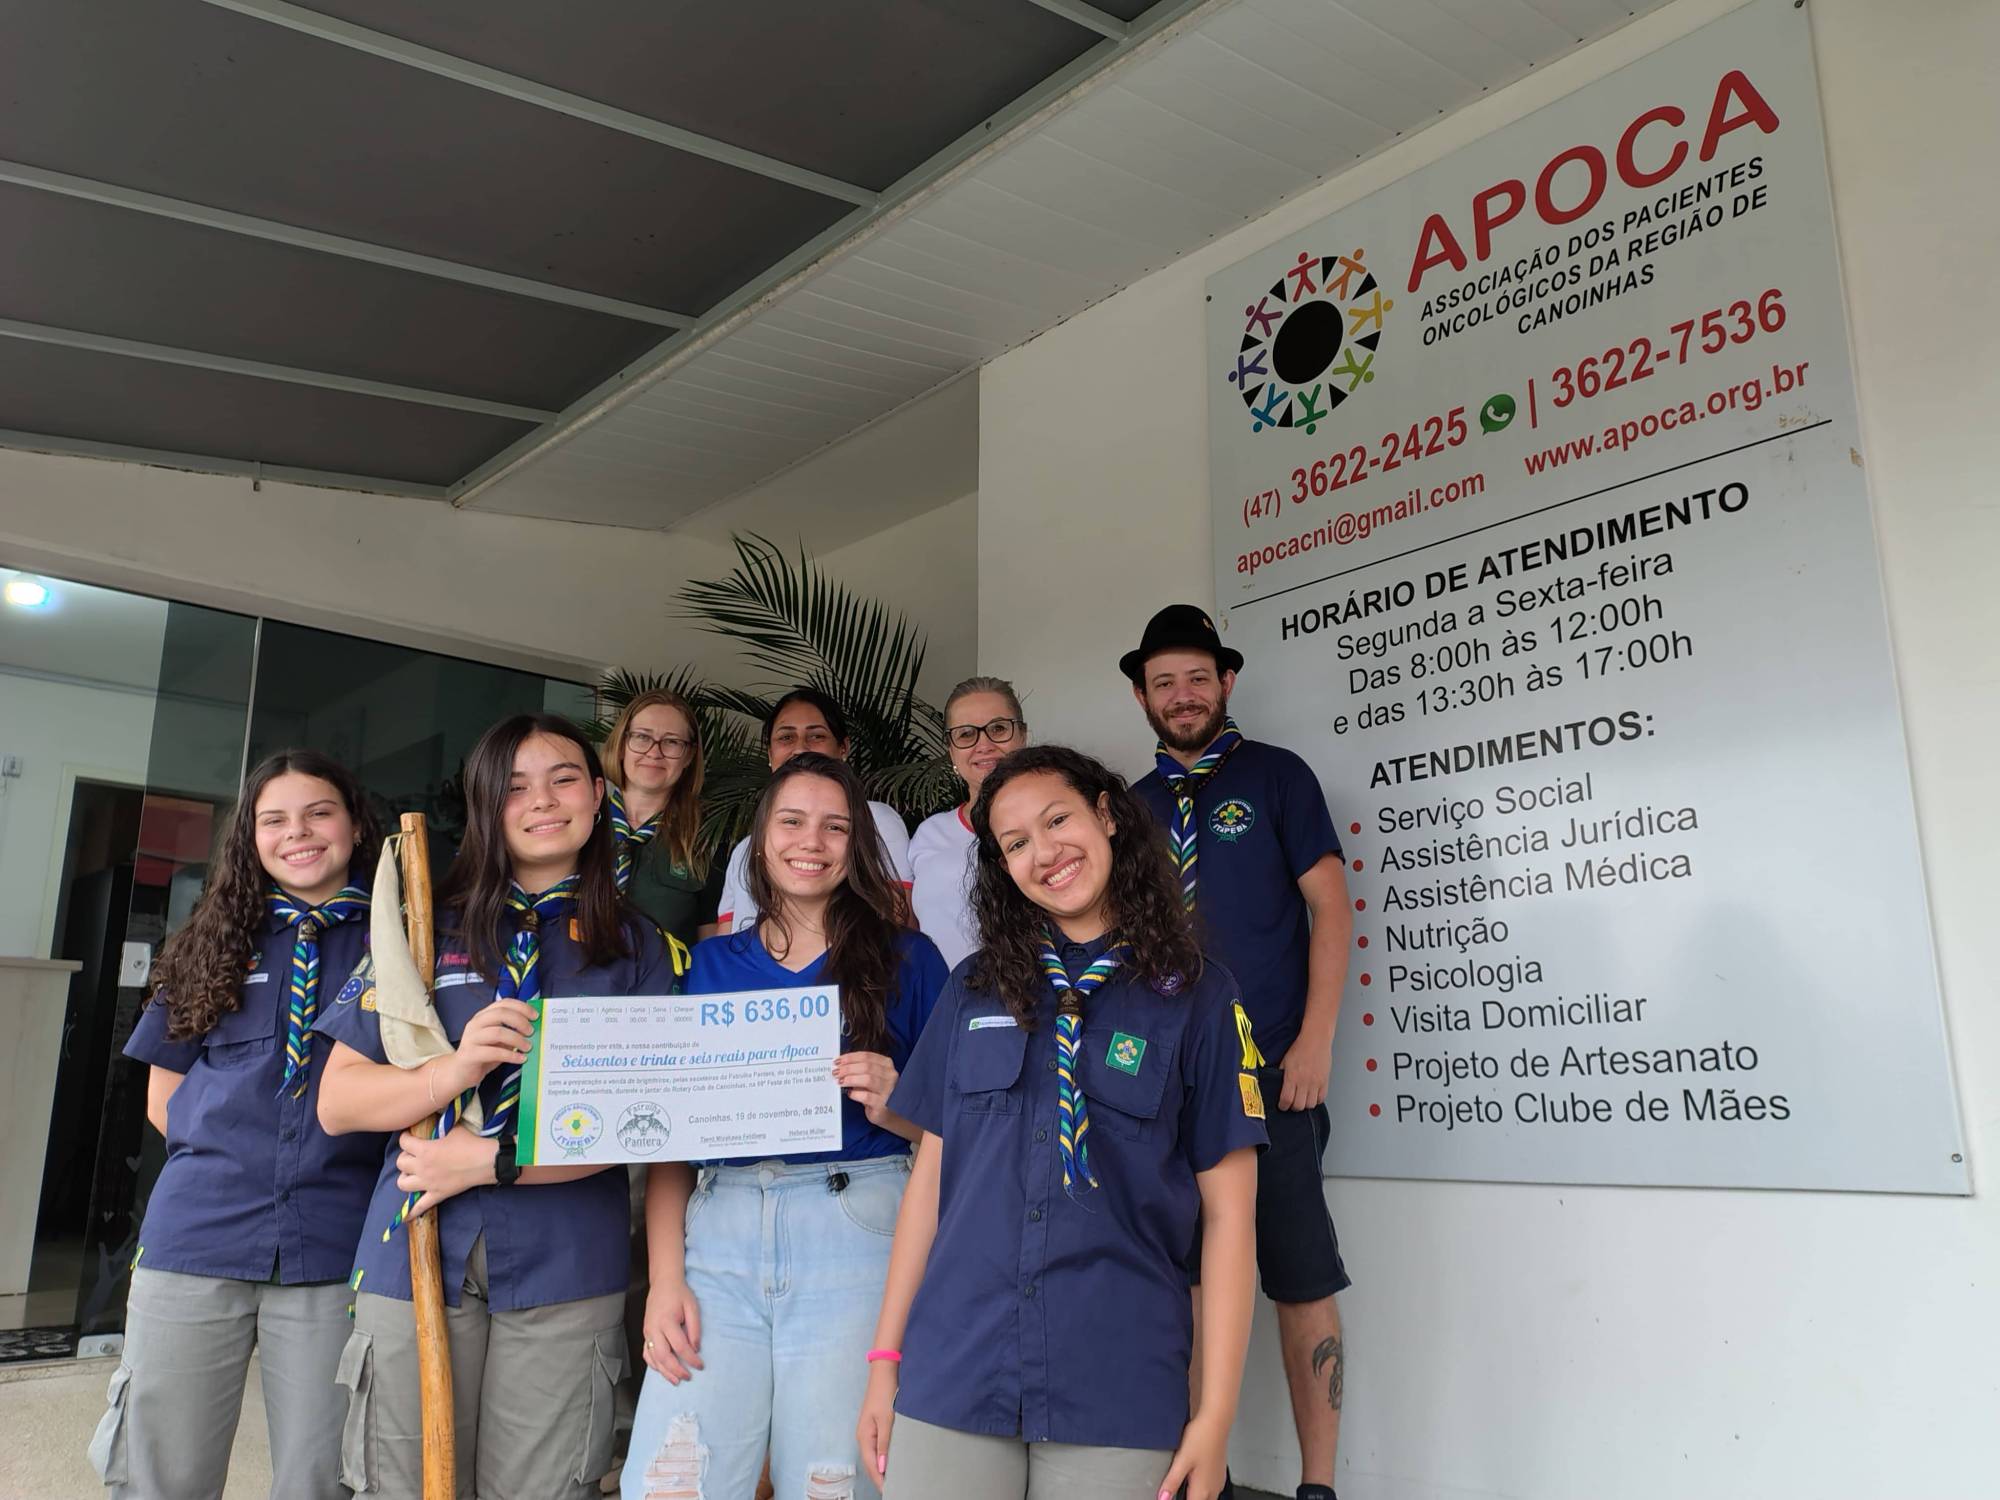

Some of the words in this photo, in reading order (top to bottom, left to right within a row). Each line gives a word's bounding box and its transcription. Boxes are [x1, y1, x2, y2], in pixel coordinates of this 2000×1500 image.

[1407, 70, 1780, 294] APOCA
[1420, 244, 1561, 322] ASSOCIAÇÃO
[1567, 220, 1615, 258] DOS
[1623, 156, 1763, 234] PACIENTES
[1422, 264, 1581, 346] ONCOLÓGICOS
[1589, 248, 1621, 278] DA
[1627, 205, 1724, 262] REGIÃO
[1732, 184, 1768, 219] DE
[1517, 263, 1654, 335] CANOINHAS
[1243, 488, 1281, 529] (47)
[1291, 406, 1468, 504] 3622-2425
[1551, 288, 1787, 408] 3622-7536
[1524, 362, 1809, 476] www.apoca.org.br
[1237, 473, 1485, 576] apocacni@gmail.com
[1281, 580, 1415, 641] HORÁRIO
[1425, 562, 1469, 600] DE
[1477, 481, 1749, 585] ATENDIMENTO
[1337, 608, 1458, 661] Segunda
[1467, 604, 1485, 626] a
[1496, 552, 1674, 618] Sexta-feira
[1349, 662, 1401, 695] Das
[1410, 637, 1491, 680] 8:00h
[1501, 628, 1538, 657] às
[1550, 593, 1663, 644] 12:00h
[1333, 715, 1349, 735] e
[1357, 700, 1406, 730] das
[1416, 671, 1515, 716] 13:30h
[1526, 663, 1563, 692] às
[1576, 630, 1693, 680] 17:00h
[1369, 710, 1656, 790] ATENDIMENTOS:
[1378, 797, 1484, 835] Serviço
[1495, 771, 1593, 815] Social
[1380, 830, 1550, 874] Assistência
[1560, 804, 1699, 848] Jurídica
[1382, 872, 1553, 913] Assistência
[1565, 853, 1692, 891] Médica
[1386, 916, 1509, 954] Nutrição
[1388, 958, 1544, 993] Psicologia
[701, 1001, 735, 1029] R$
[743, 994, 831, 1025] 636,00
[1390, 1004, 1471, 1034] Visita
[1481, 993, 1648, 1030] Domiciliar
[560, 1053, 628, 1069] Seissentos
[629, 1056, 639, 1067] e
[640, 1053, 677, 1067] trinta
[679, 1055, 688, 1065] e
[688, 1053, 713, 1065] seis
[713, 1050, 747, 1063] reais
[746, 1048, 777, 1066] para
[780, 1044, 820, 1062] Apoca
[1393, 1050, 1499, 1088] Projeto
[1510, 1047, 1550, 1078] de
[1559, 1038, 1759, 1077] Artesanato
[624, 1136, 661, 1149] Pantera
[747, 1111, 757, 1120] de
[758, 1108, 801, 1119] novembro,
[802, 1107, 813, 1116] de
[1396, 1094, 1503, 1132] Projeto
[1514, 1091, 1613, 1124] Clube
[1625, 1089, 1670, 1123] de
[1682, 1088, 1791, 1122] Mães
